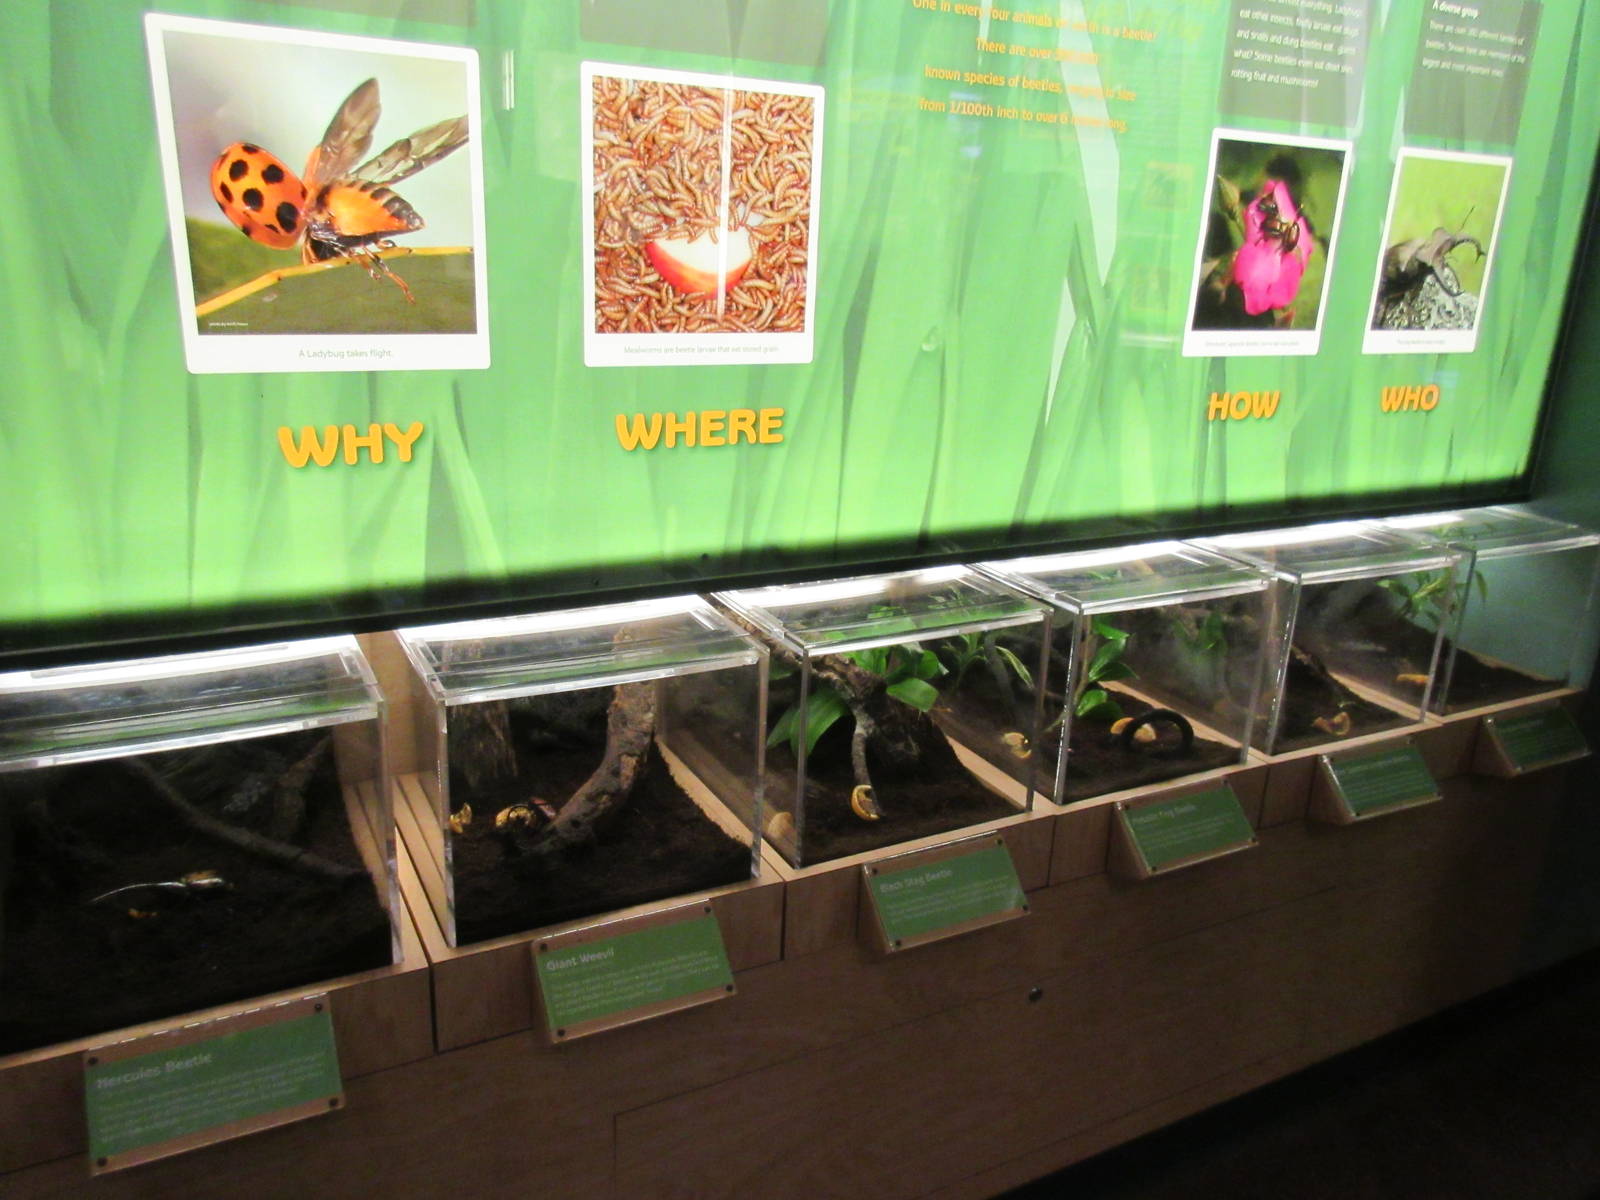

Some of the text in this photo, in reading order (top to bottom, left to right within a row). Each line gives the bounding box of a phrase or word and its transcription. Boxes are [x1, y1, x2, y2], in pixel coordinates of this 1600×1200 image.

[913, 0, 936, 10] One
[940, 0, 951, 12] in
[954, 4, 984, 20] every
[1012, 10, 1053, 27] animals
[975, 37, 1007, 53] There
[1008, 44, 1026, 56] are
[1028, 46, 1052, 59] over
[924, 63, 961, 82] known
[963, 71, 1005, 86] species
[1008, 73, 1020, 87] of
[919, 97, 946, 112] from
[950, 99, 993, 117] 1/100th
[996, 104, 1019, 120] inch
[1021, 107, 1033, 121] to
[1036, 110, 1058, 124] over
[298, 348, 306, 359] A
[306, 348, 345, 361] Ladybug
[346, 348, 369, 359] takes
[717, 342, 730, 353] that
[1207, 390, 1280, 421] HOW
[1380, 383, 1441, 413] WHO
[615, 407, 785, 451] WHERE
[277, 420, 424, 468] WHY
[546, 955, 578, 972] Giant
[164, 1052, 214, 1074] Beetle
